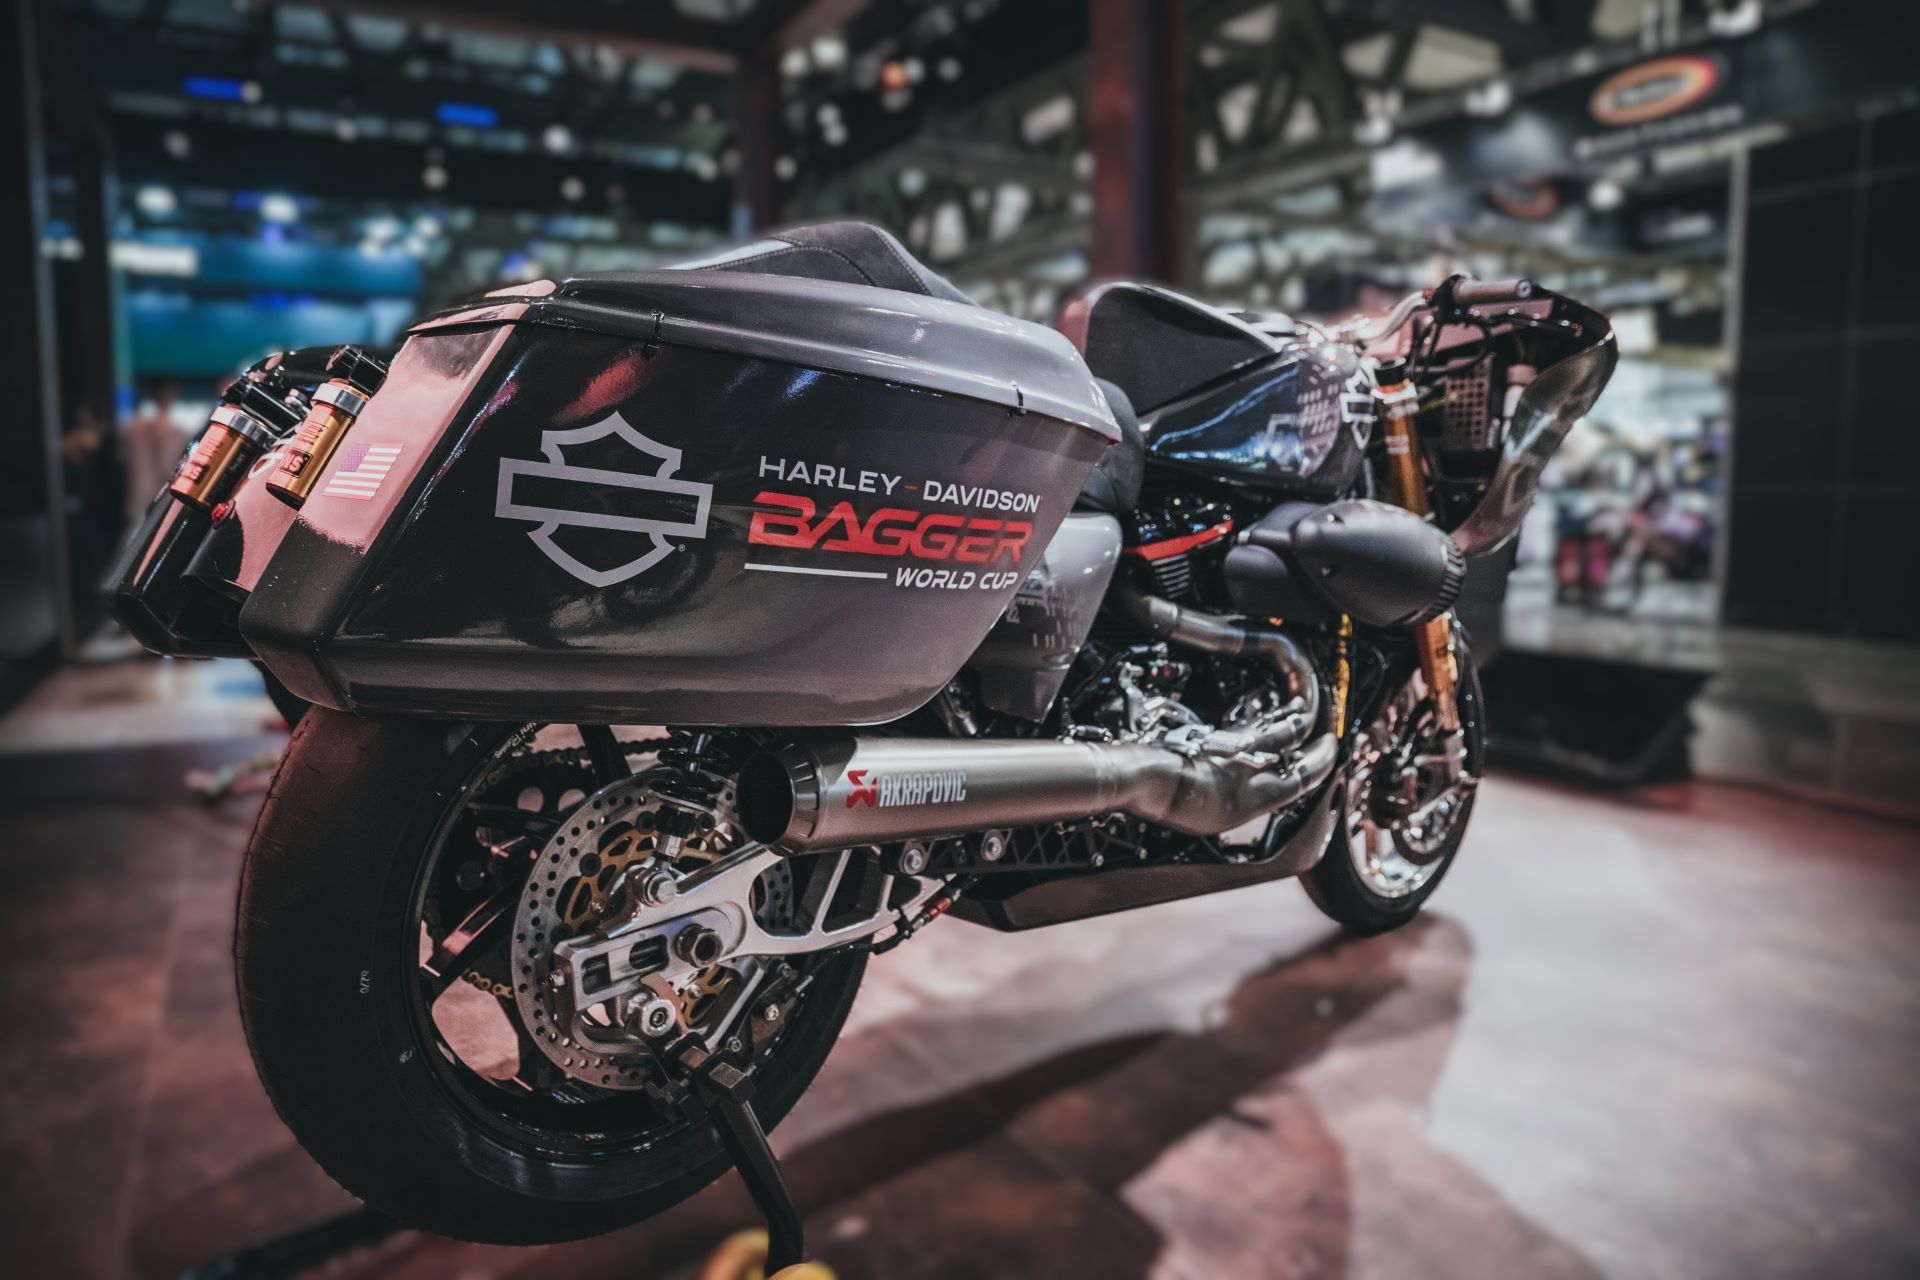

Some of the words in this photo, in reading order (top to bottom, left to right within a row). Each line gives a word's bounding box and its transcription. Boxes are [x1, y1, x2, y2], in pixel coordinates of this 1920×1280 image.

[748, 491, 1034, 564] BAGGER
[895, 567, 976, 590] WORLD
[979, 571, 1019, 590] CUP
